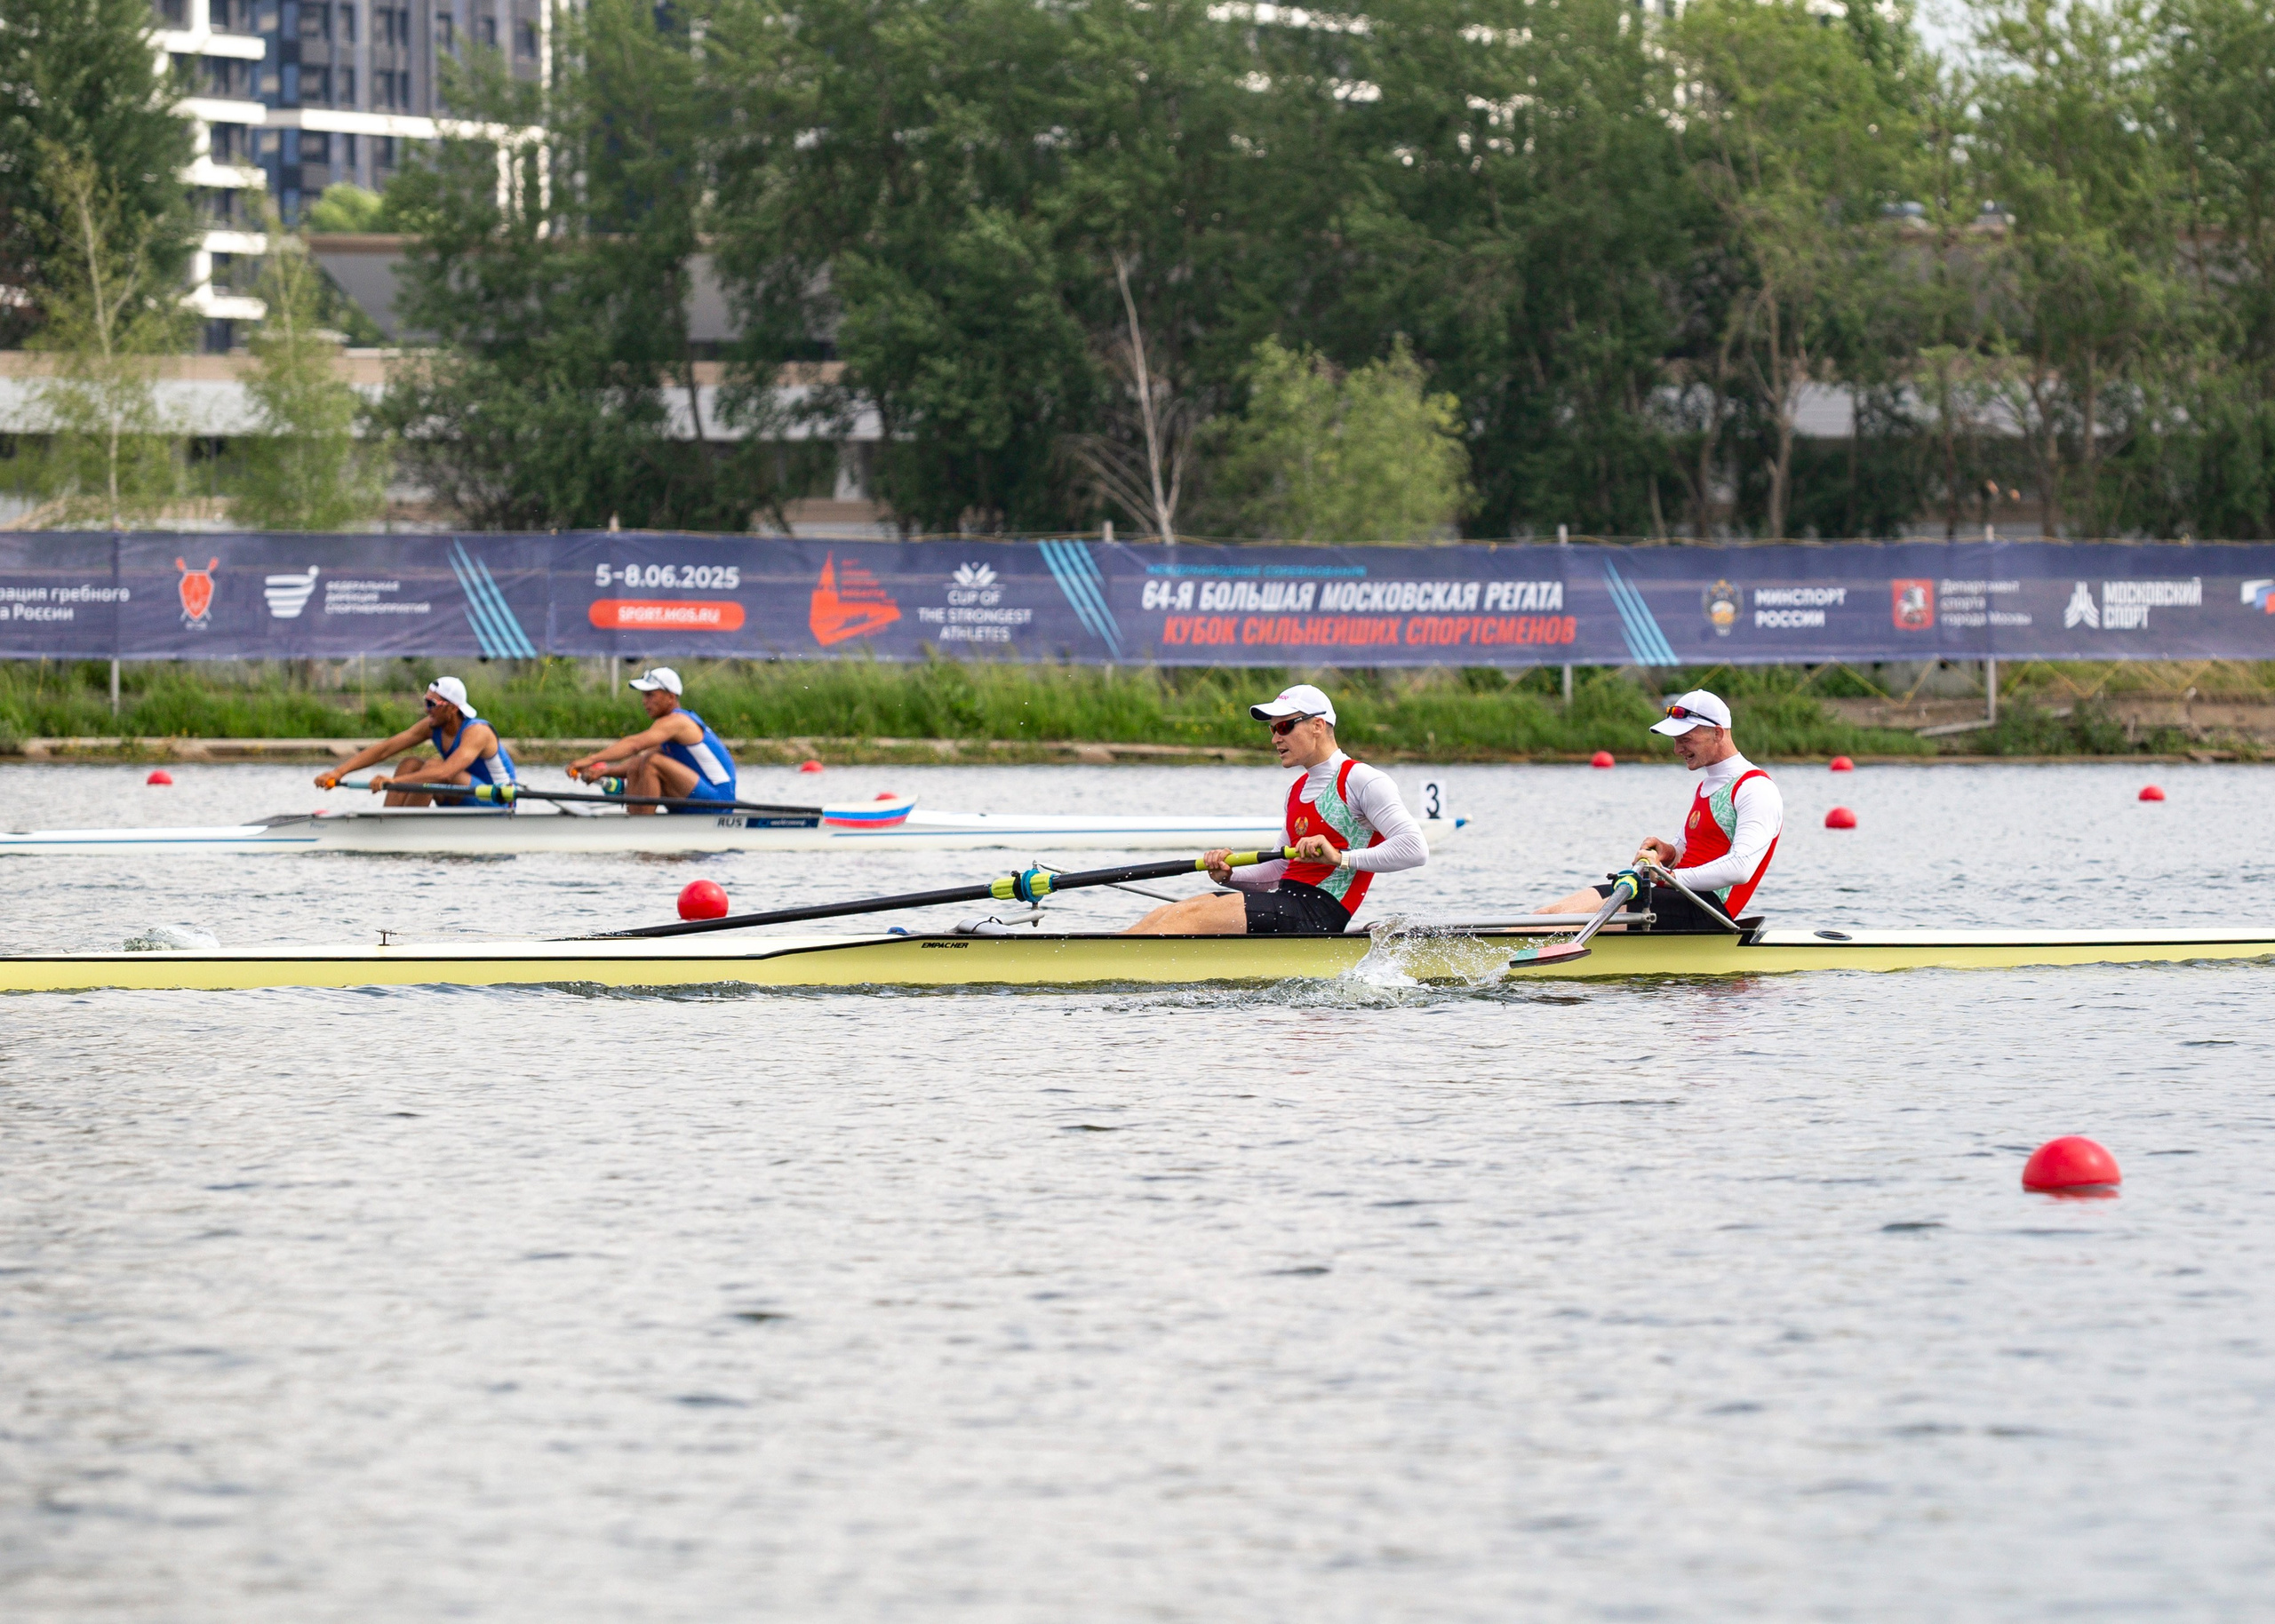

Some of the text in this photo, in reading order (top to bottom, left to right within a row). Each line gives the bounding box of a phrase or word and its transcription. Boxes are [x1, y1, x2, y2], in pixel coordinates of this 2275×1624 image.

[595, 563, 740, 589] 5-8.06.2025
[51, 585, 130, 605] гребного
[947, 590, 1002, 605] CUP OF
[1141, 580, 1563, 612] 64-Я БОЛЬШАЯ МОСКОВСКАЯ РЕГАТА
[1754, 588, 1848, 606] МИНСПОРТ
[2103, 577, 2202, 606] МОСКОВСКИЙ
[12, 603, 74, 621] России
[618, 606, 721, 624] SPORT.MOS.RU
[917, 607, 1033, 624] THE STRONGEST
[1754, 609, 1825, 628] РОССИИ
[2103, 605, 2150, 629] СПОРТ
[939, 625, 1011, 642] ATHLETES
[1162, 615, 1577, 646] КУБОК СИЛЬНЕЙШИХ СПОРТСМЕНОВ
[1426, 783, 1440, 816] 3
[717, 816, 743, 828] RUS
